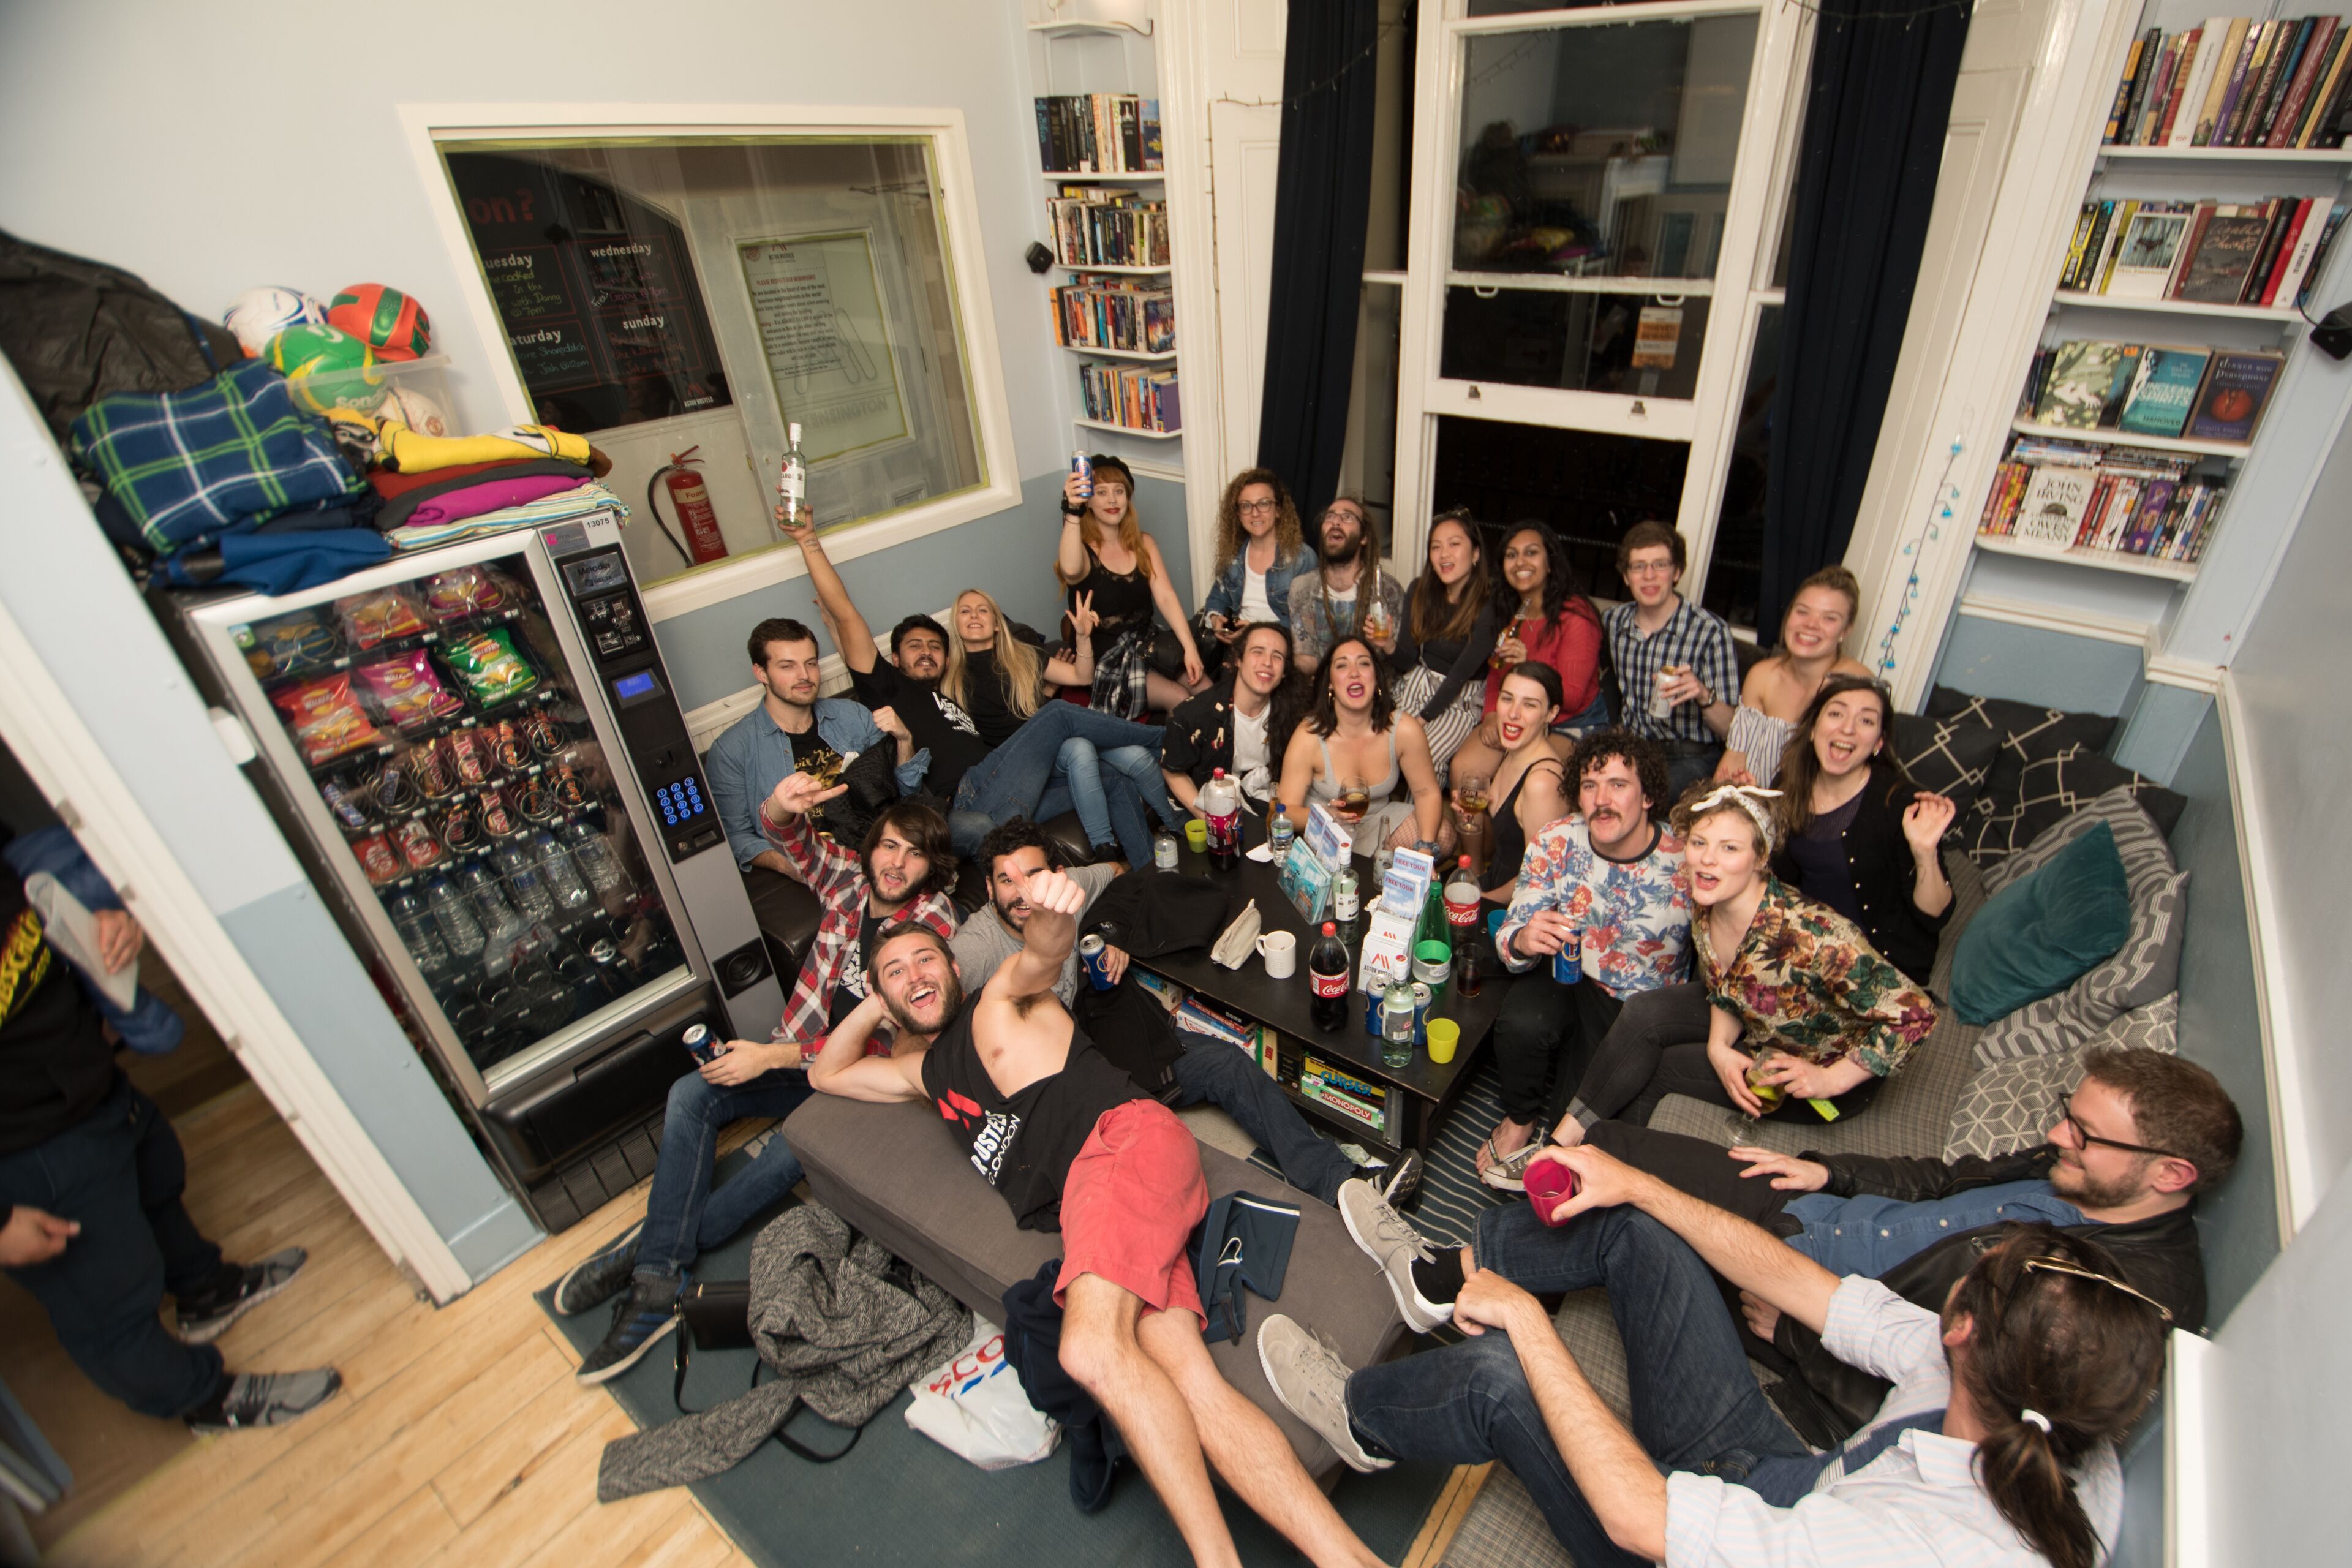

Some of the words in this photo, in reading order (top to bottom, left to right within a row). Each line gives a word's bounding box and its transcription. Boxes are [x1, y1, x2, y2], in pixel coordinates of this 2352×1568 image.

[590, 243, 652, 258] wednesday
[622, 314, 665, 329] sunday
[2047, 478, 2082, 493] JOHN
[686, 489, 704, 499] Foam
[2037, 489, 2084, 505] IRVING
[586, 518, 610, 528] 13075
[2030, 521, 2070, 533] OWEN
[2024, 527, 2071, 543] MEANY
[577, 562, 611, 576] Melodia
[470, 641, 500, 659] WALKERS
[1395, 858, 1410, 868] FREE
[1410, 861, 1425, 872] TOUR
[1385, 876, 1398, 886] FREE
[1398, 882, 1414, 892] TOUR
[1363, 965, 1376, 973] ASTOR
[1377, 968, 1395, 980] HOSTEL
[1196, 1004, 1211, 1016] FANTASTIC
[1211, 1011, 1224, 1023] DRINKING
[1224, 1020, 1234, 1029] GAMES
[1320, 1071, 1373, 1096] CURSES!
[1324, 1091, 1371, 1119] MONOPOLY
